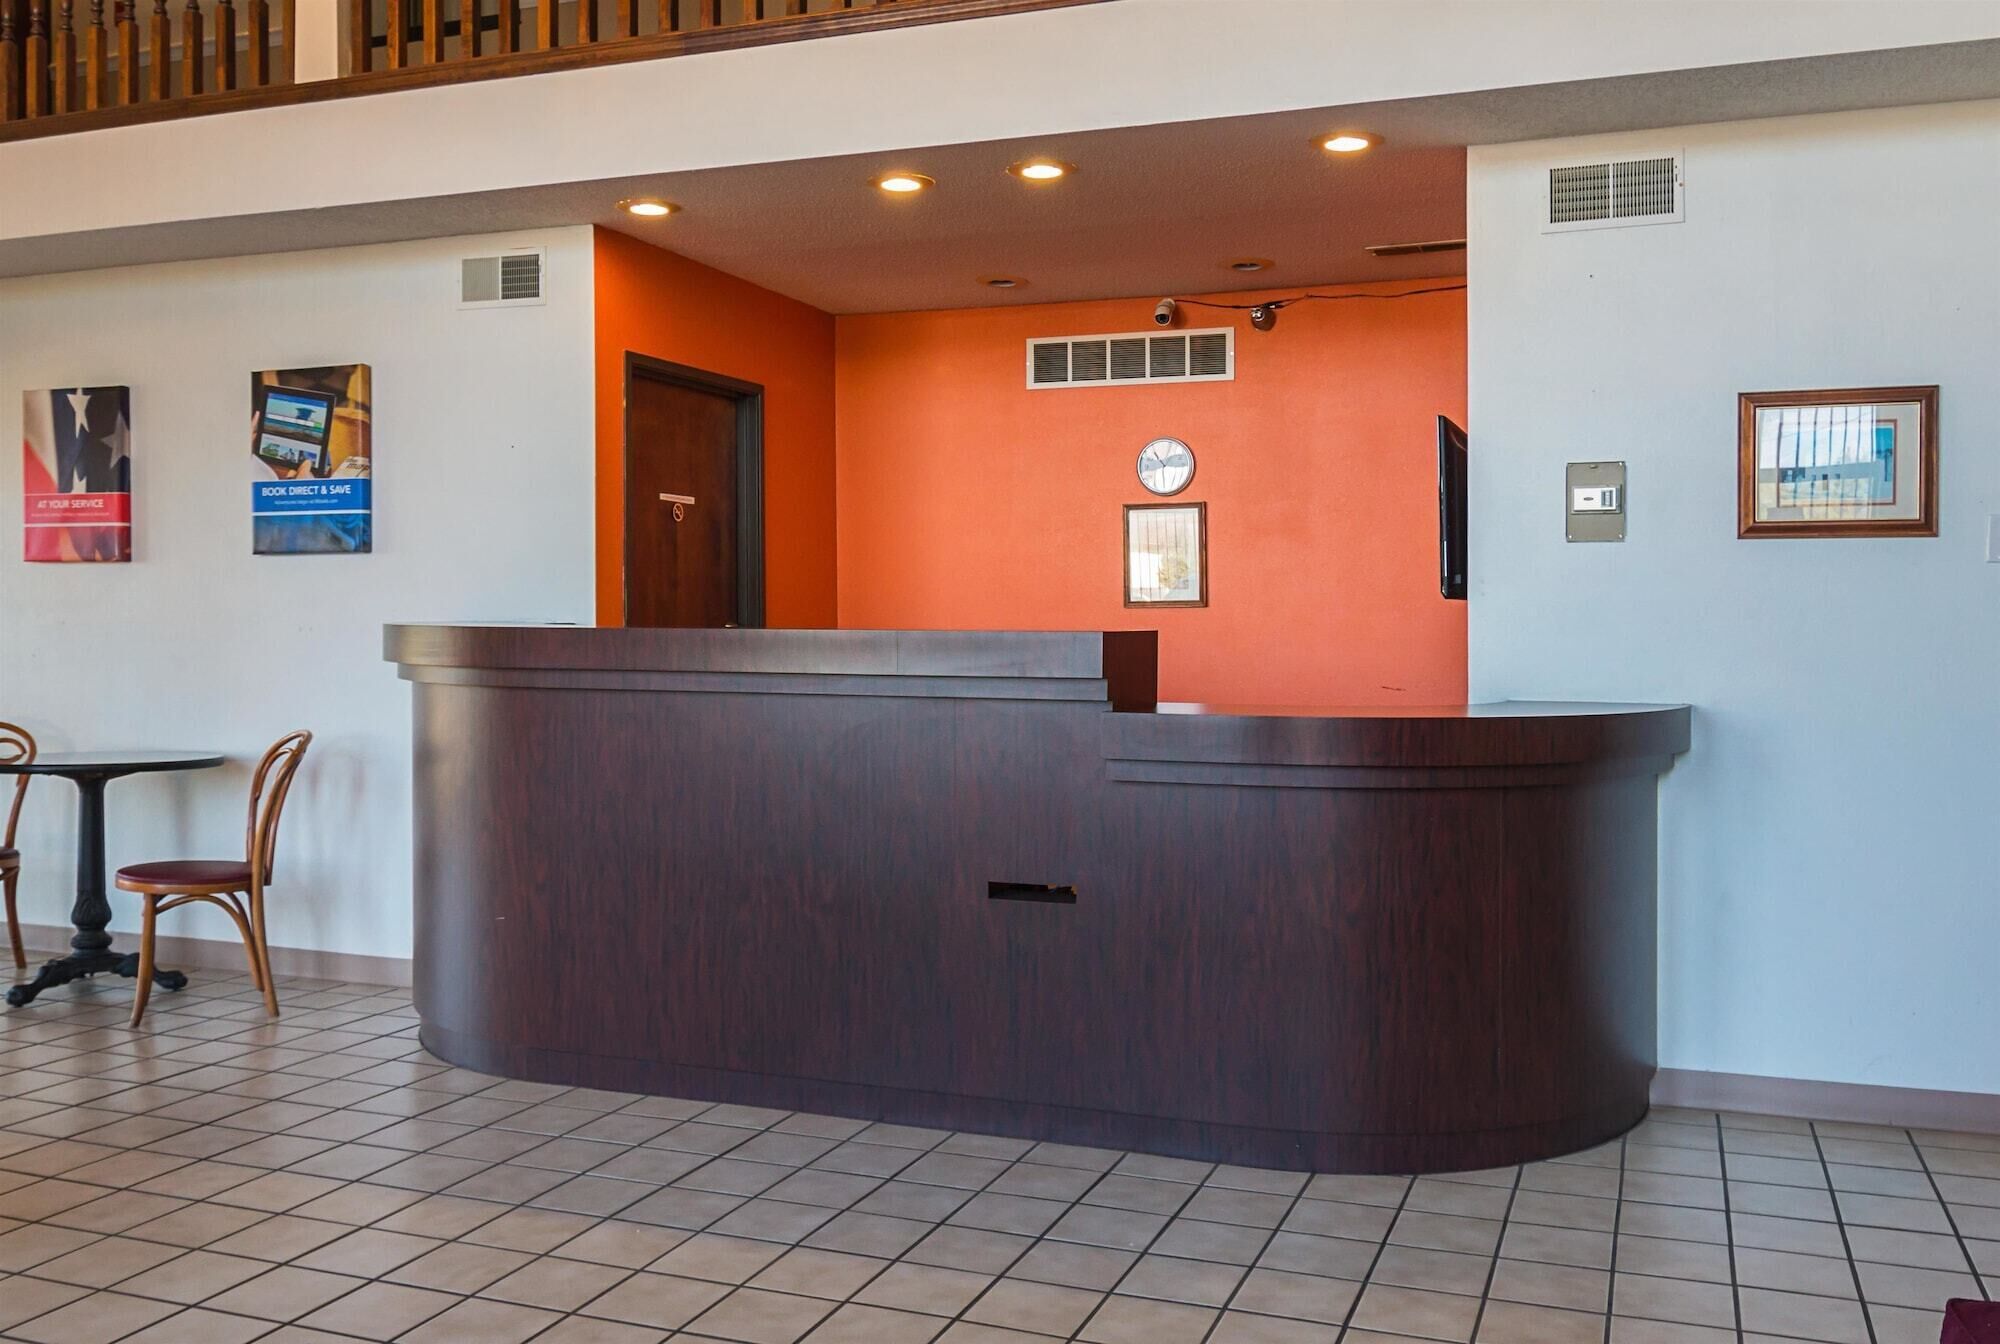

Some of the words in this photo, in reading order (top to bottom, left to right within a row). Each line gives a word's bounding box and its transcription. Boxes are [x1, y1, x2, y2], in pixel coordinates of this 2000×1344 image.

[262, 487, 287, 497] BOOK
[288, 486, 319, 496] DIRECT
[321, 485, 328, 495] &
[330, 485, 351, 494] SAVE
[48, 500, 69, 508] YOUR
[71, 499, 104, 508] SERVICE
